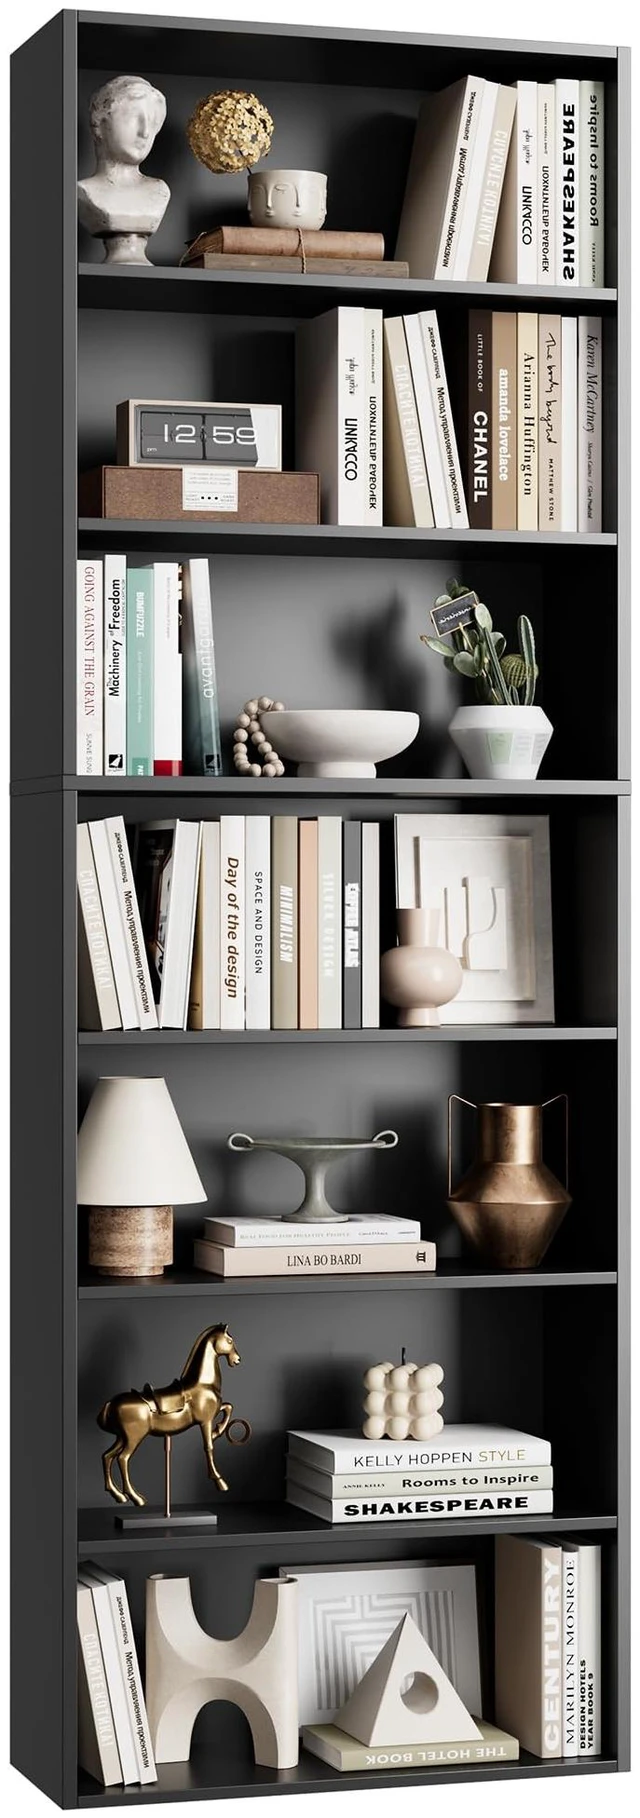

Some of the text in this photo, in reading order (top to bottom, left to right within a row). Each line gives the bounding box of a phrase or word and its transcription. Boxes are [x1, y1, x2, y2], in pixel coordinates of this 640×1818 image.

[477, 382, 483, 393] OF
[499, 368, 511, 482] amanda lovelace
[520, 352, 535, 497] Arianna Huffington
[540, 332, 559, 445] The body beyond
[582, 333, 599, 434] Karen McCartney
[163, 423, 258, 445] 12 59
[436, 387, 463, 514] Метод управления проектами
[473, 410, 488, 504] CHANEL
[84, 566, 95, 717] GOING AGAINST THE GRAIN
[108, 579, 121, 630] Freedom
[136, 591, 145, 639] BUMFUZZLE
[108, 640, 122, 697] Machinery
[123, 890, 150, 1014] Метод управления проектами
[225, 857, 239, 999] Day of the design
[254, 871, 263, 975] SPACE AND DESIGN
[279, 884, 293, 963] MINIMALISM
[287, 1253, 362, 1267] LINA BO BARDI
[354, 1449, 526, 1467] KELLY HOPPEN STYLE
[402, 1473, 539, 1488] Rooms to Inspire
[344, 1497, 529, 1516] SHAKESPEARE
[543, 1557, 560, 1751] CENTURY
[565, 1559, 575, 1744] MARILYN MONROE
[587, 1672, 594, 1680] 9
[125, 1651, 150, 1769] Метод управления проектами
[365, 1746, 507, 1765] THE HOTEL BOOK
